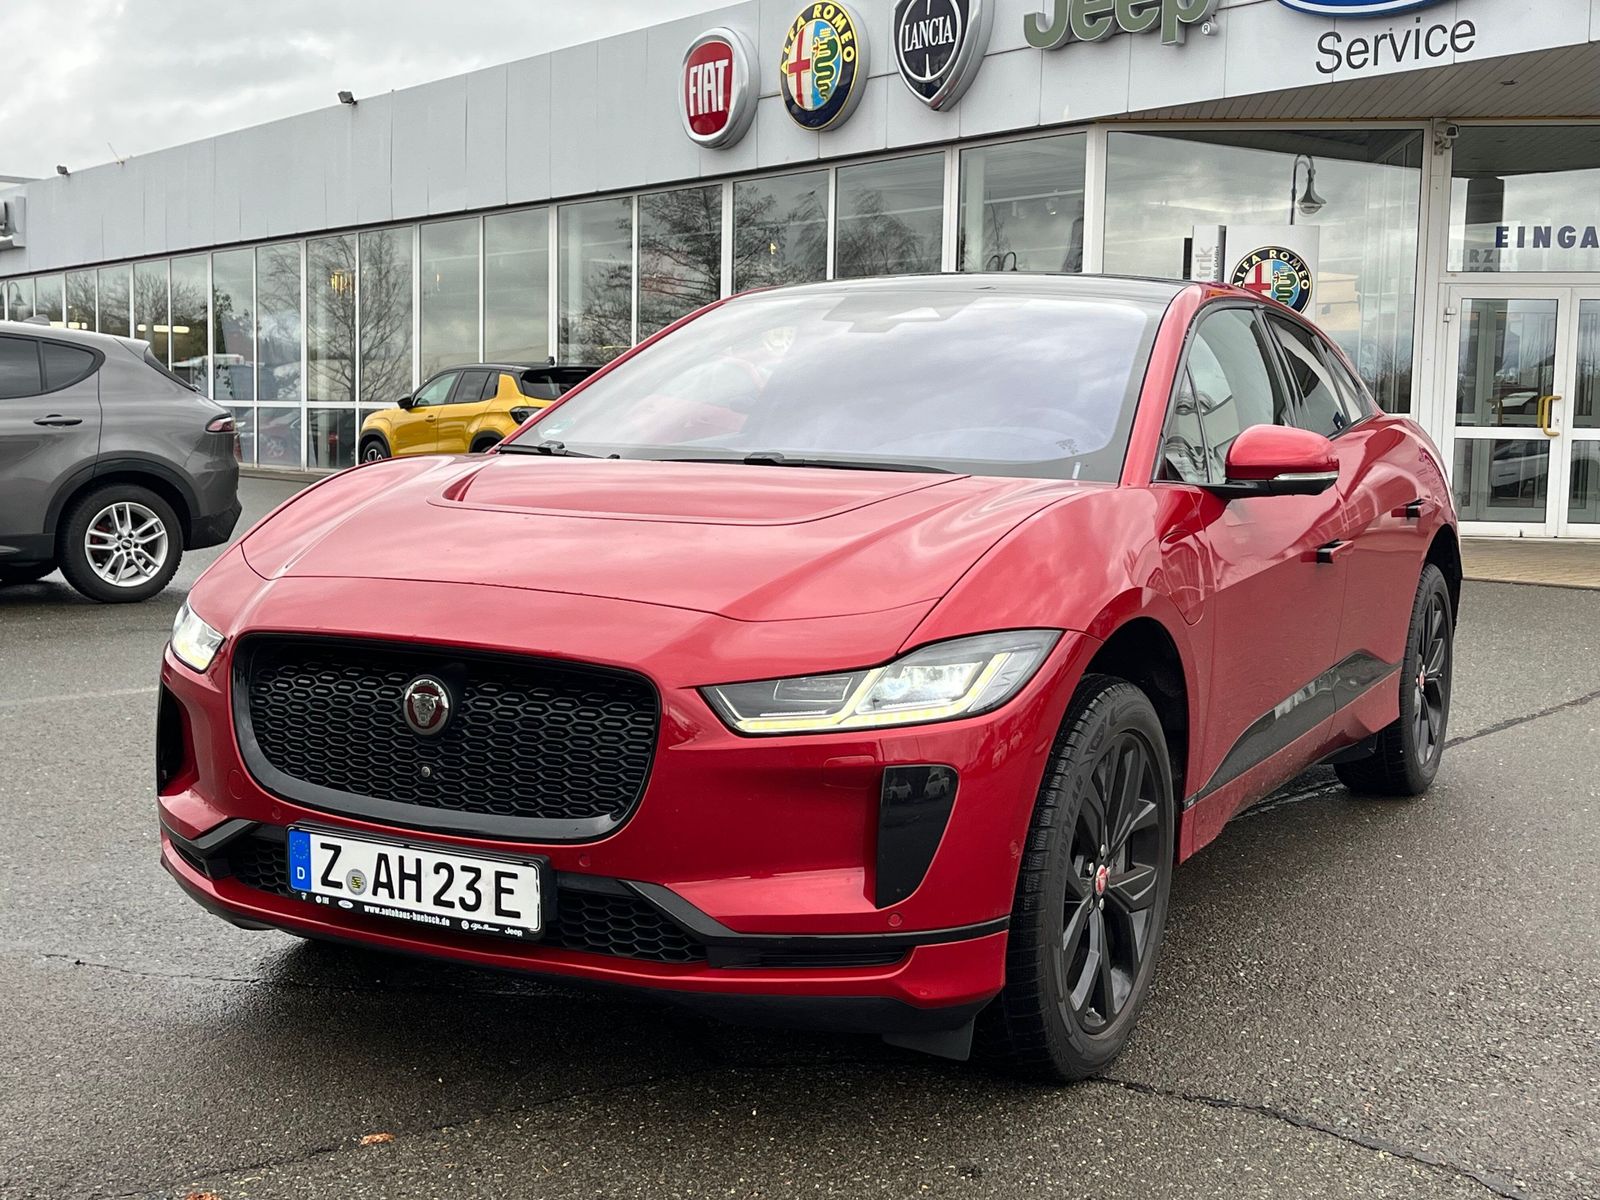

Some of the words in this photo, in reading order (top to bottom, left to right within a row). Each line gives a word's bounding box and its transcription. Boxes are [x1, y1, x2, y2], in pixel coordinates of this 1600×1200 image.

[780, 19, 806, 74] ALFA
[812, 4, 855, 63] ROMEO
[904, 15, 955, 52] LANCIA
[1023, 0, 1211, 49] Jeep
[1315, 17, 1476, 75] Service
[688, 58, 729, 117] FIAT
[1495, 225, 1600, 249] EINGA
[1233, 254, 1261, 287] ALFA
[1269, 249, 1310, 290] ROMEO
[320, 842, 343, 890] Z
[363, 904, 451, 927] www.autohaus-huebsch.de
